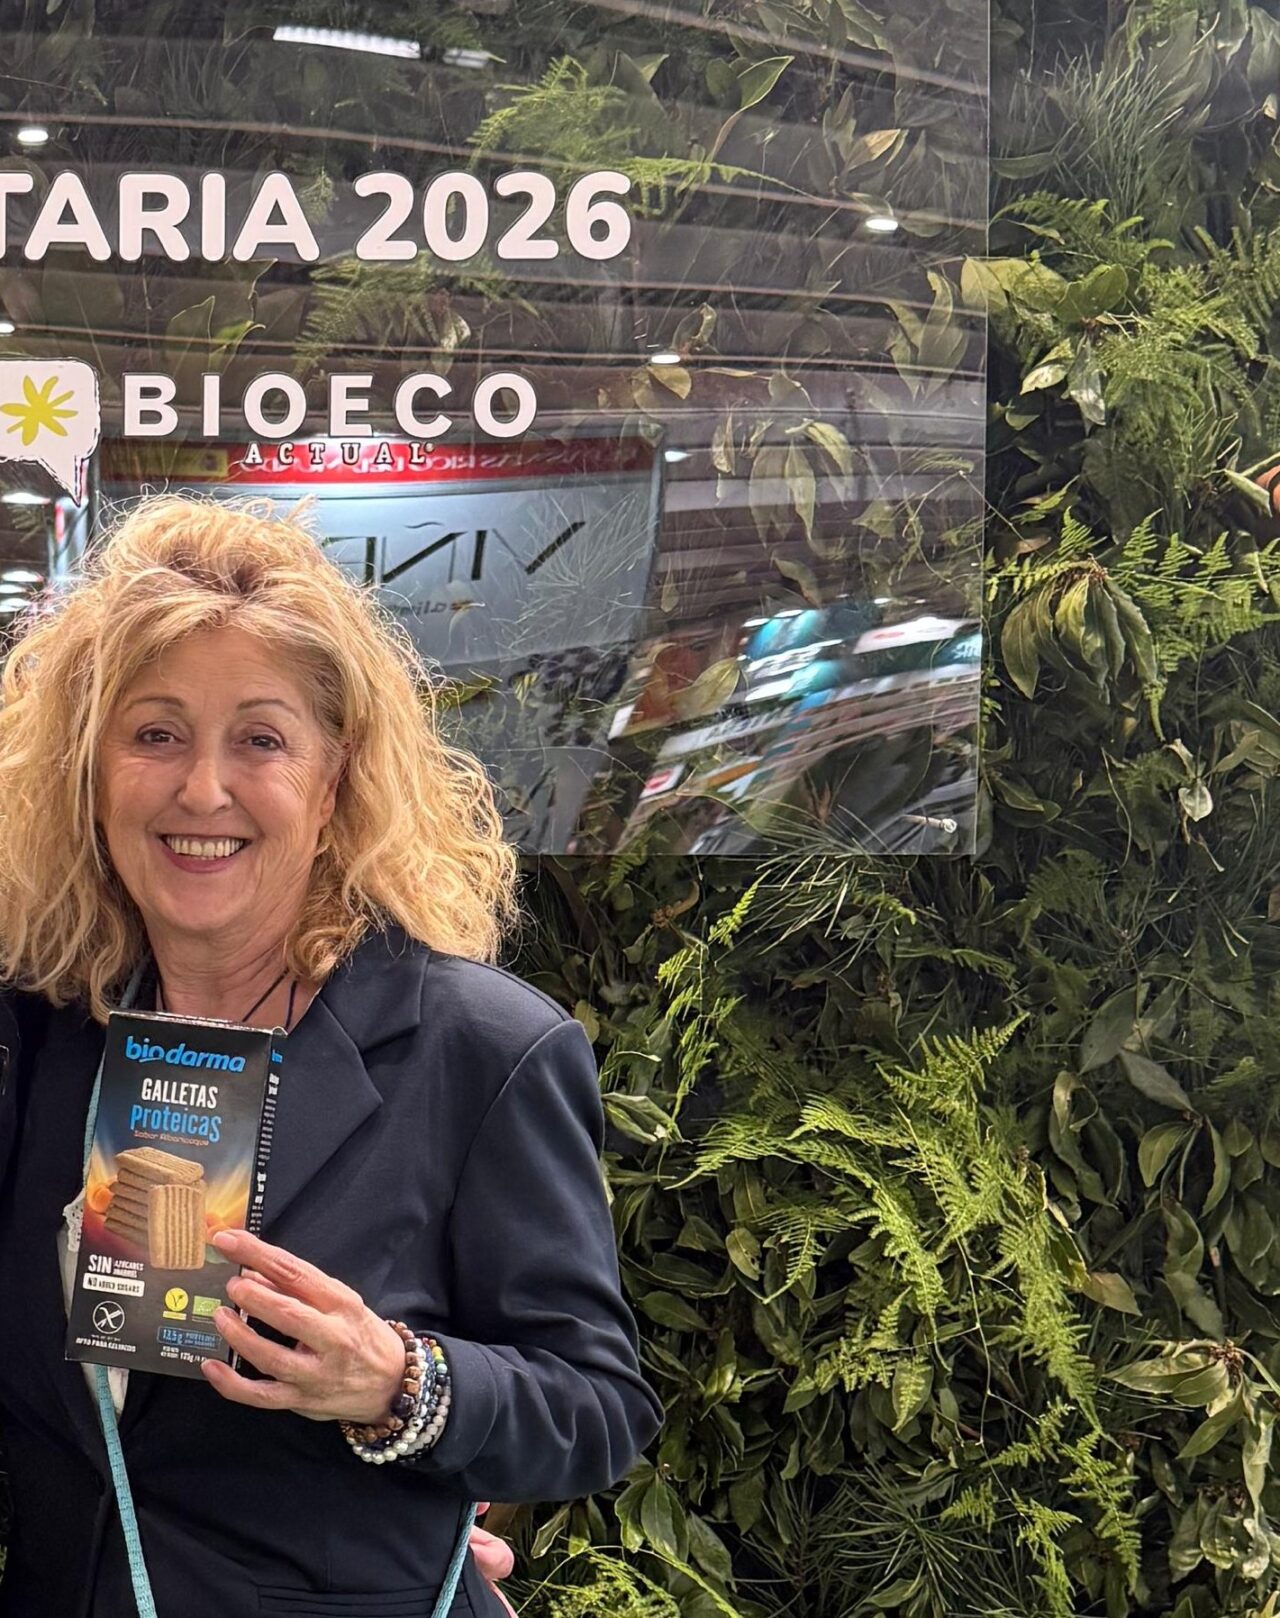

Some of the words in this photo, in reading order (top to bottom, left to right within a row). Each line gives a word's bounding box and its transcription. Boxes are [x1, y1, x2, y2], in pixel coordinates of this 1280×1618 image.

[353, 170, 632, 262] 2026
[122, 372, 538, 439] BIOECO
[124, 1035, 247, 1074] biodarma
[141, 1077, 219, 1110] GALLETAS
[88, 1254, 112, 1274] SIN
